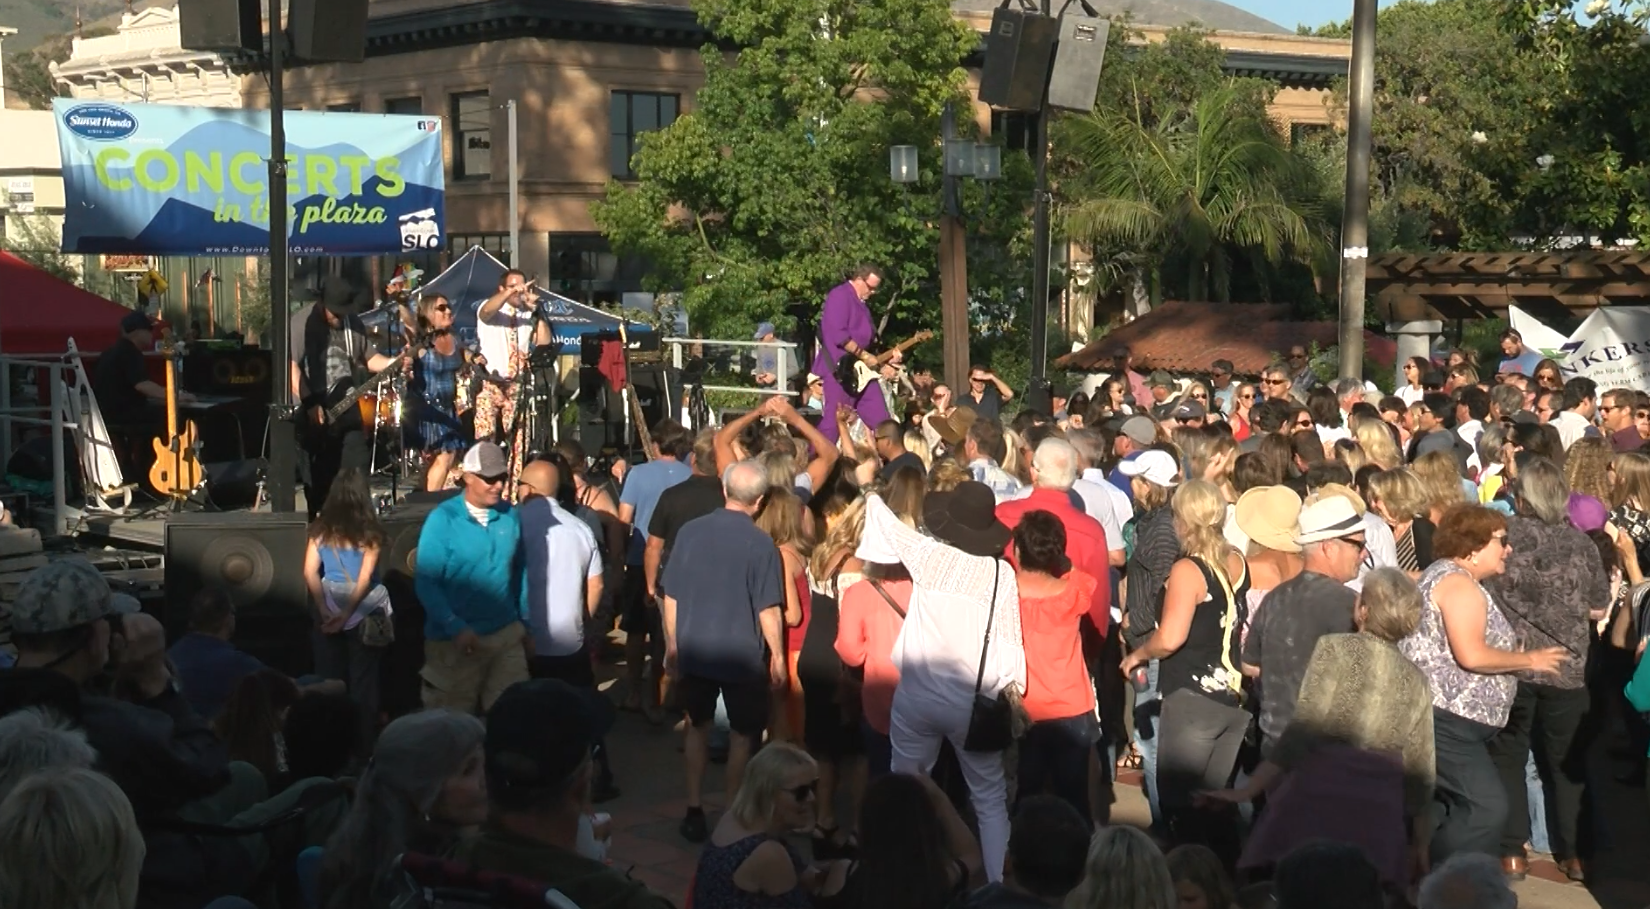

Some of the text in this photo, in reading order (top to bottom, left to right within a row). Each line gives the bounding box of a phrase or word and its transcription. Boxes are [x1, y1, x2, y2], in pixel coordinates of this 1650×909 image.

[70, 114, 132, 128] Sunset Honda
[96, 147, 405, 197] CONCERTS
[214, 197, 243, 223] in
[300, 197, 387, 233] plaza
[404, 234, 439, 249] SLO
